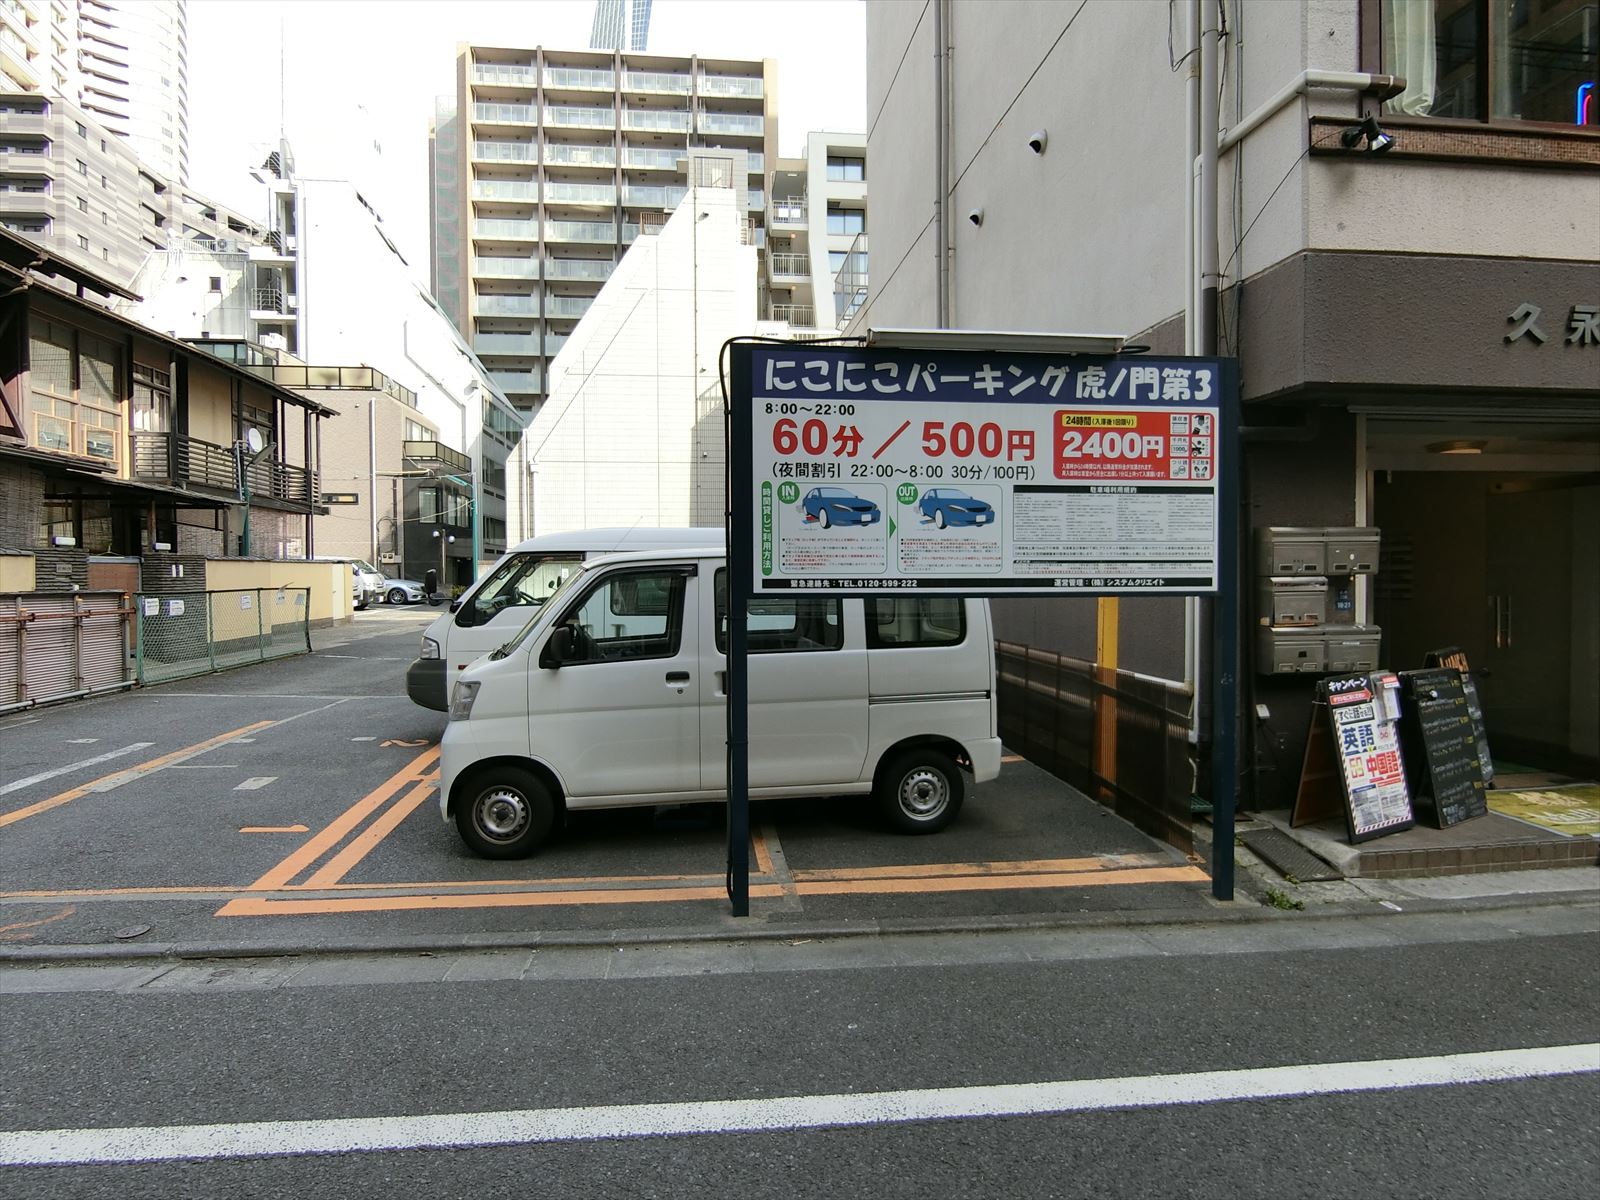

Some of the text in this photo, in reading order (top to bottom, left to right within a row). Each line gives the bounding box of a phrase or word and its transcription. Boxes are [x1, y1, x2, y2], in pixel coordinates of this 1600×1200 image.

[1062, 430, 1164, 459] 2400円
[781, 485, 795, 497] IN
[899, 486, 916, 497] OUT
[1328, 677, 1367, 692] キャンペーン
[1342, 723, 1375, 750] 英語
[1366, 751, 1399, 778] 中国語
